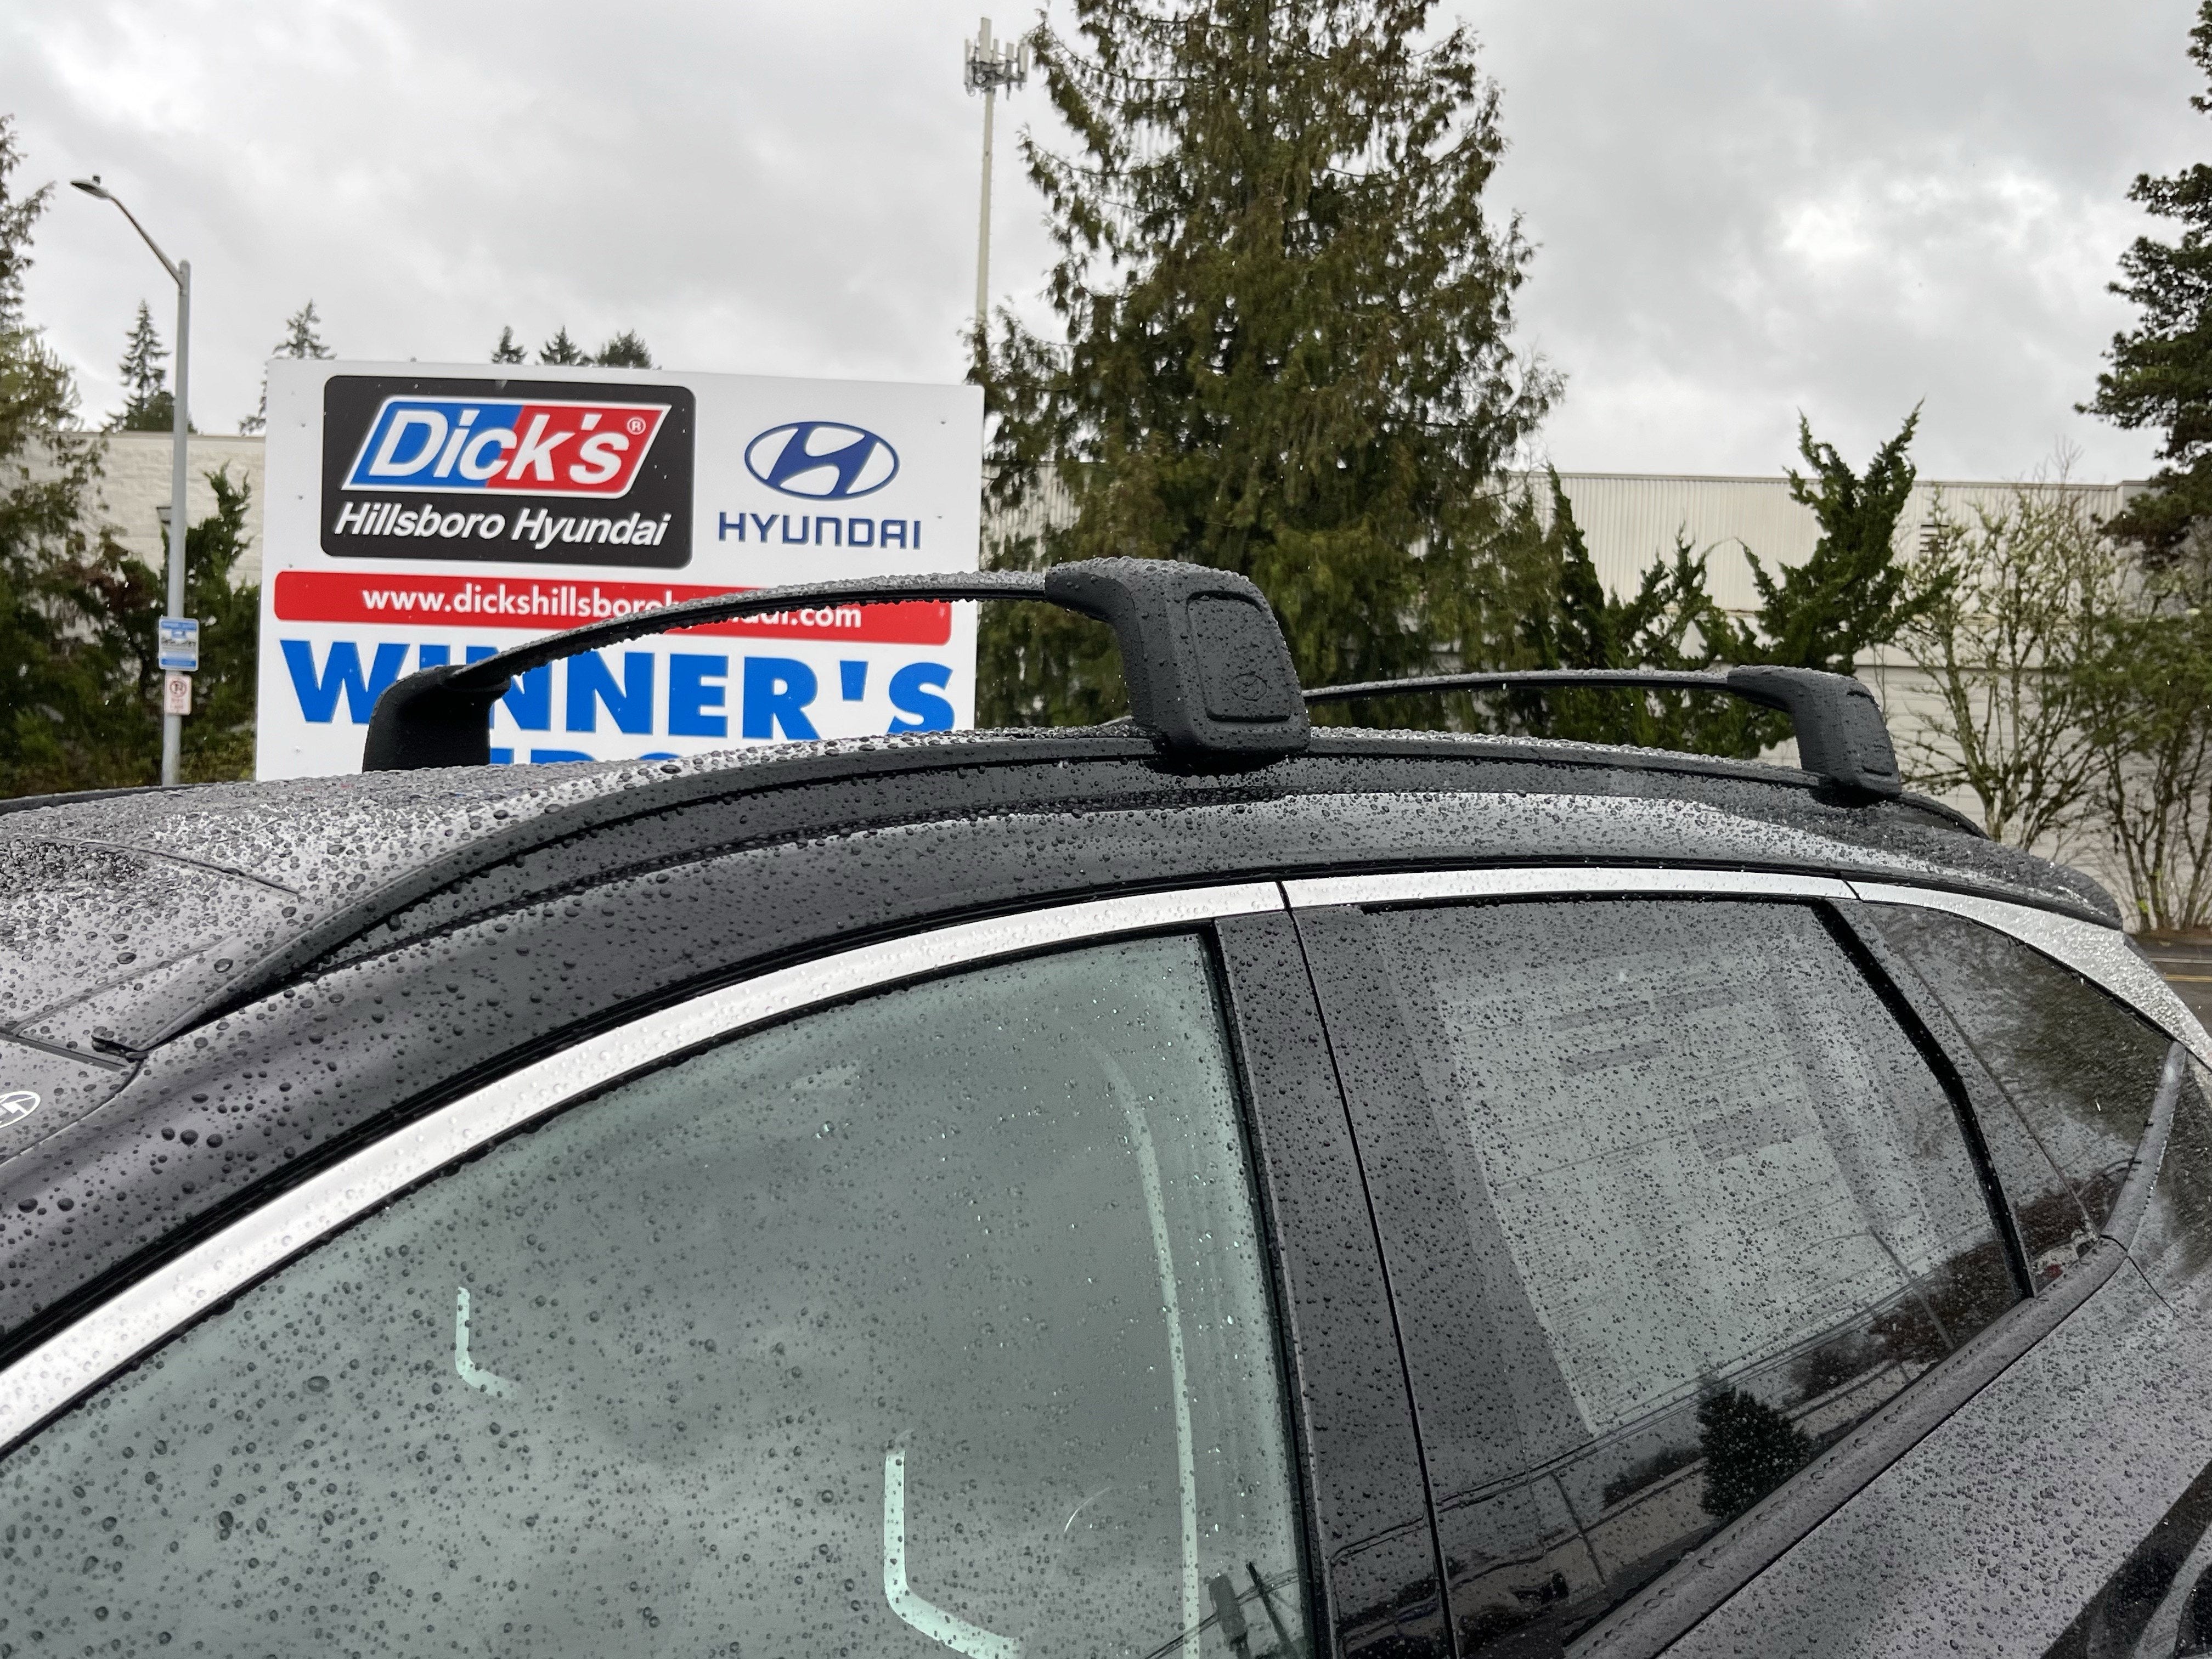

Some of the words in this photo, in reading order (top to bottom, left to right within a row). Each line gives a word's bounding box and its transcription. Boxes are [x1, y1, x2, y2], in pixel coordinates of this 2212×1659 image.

[334, 501, 505, 540] Hillsboro
[511, 508, 672, 550] Hyundai
[719, 512, 921, 550] HYUNDAI
[362, 583, 862, 628] www.dickshillsboroa.com
[279, 639, 955, 741] WNNER'S
